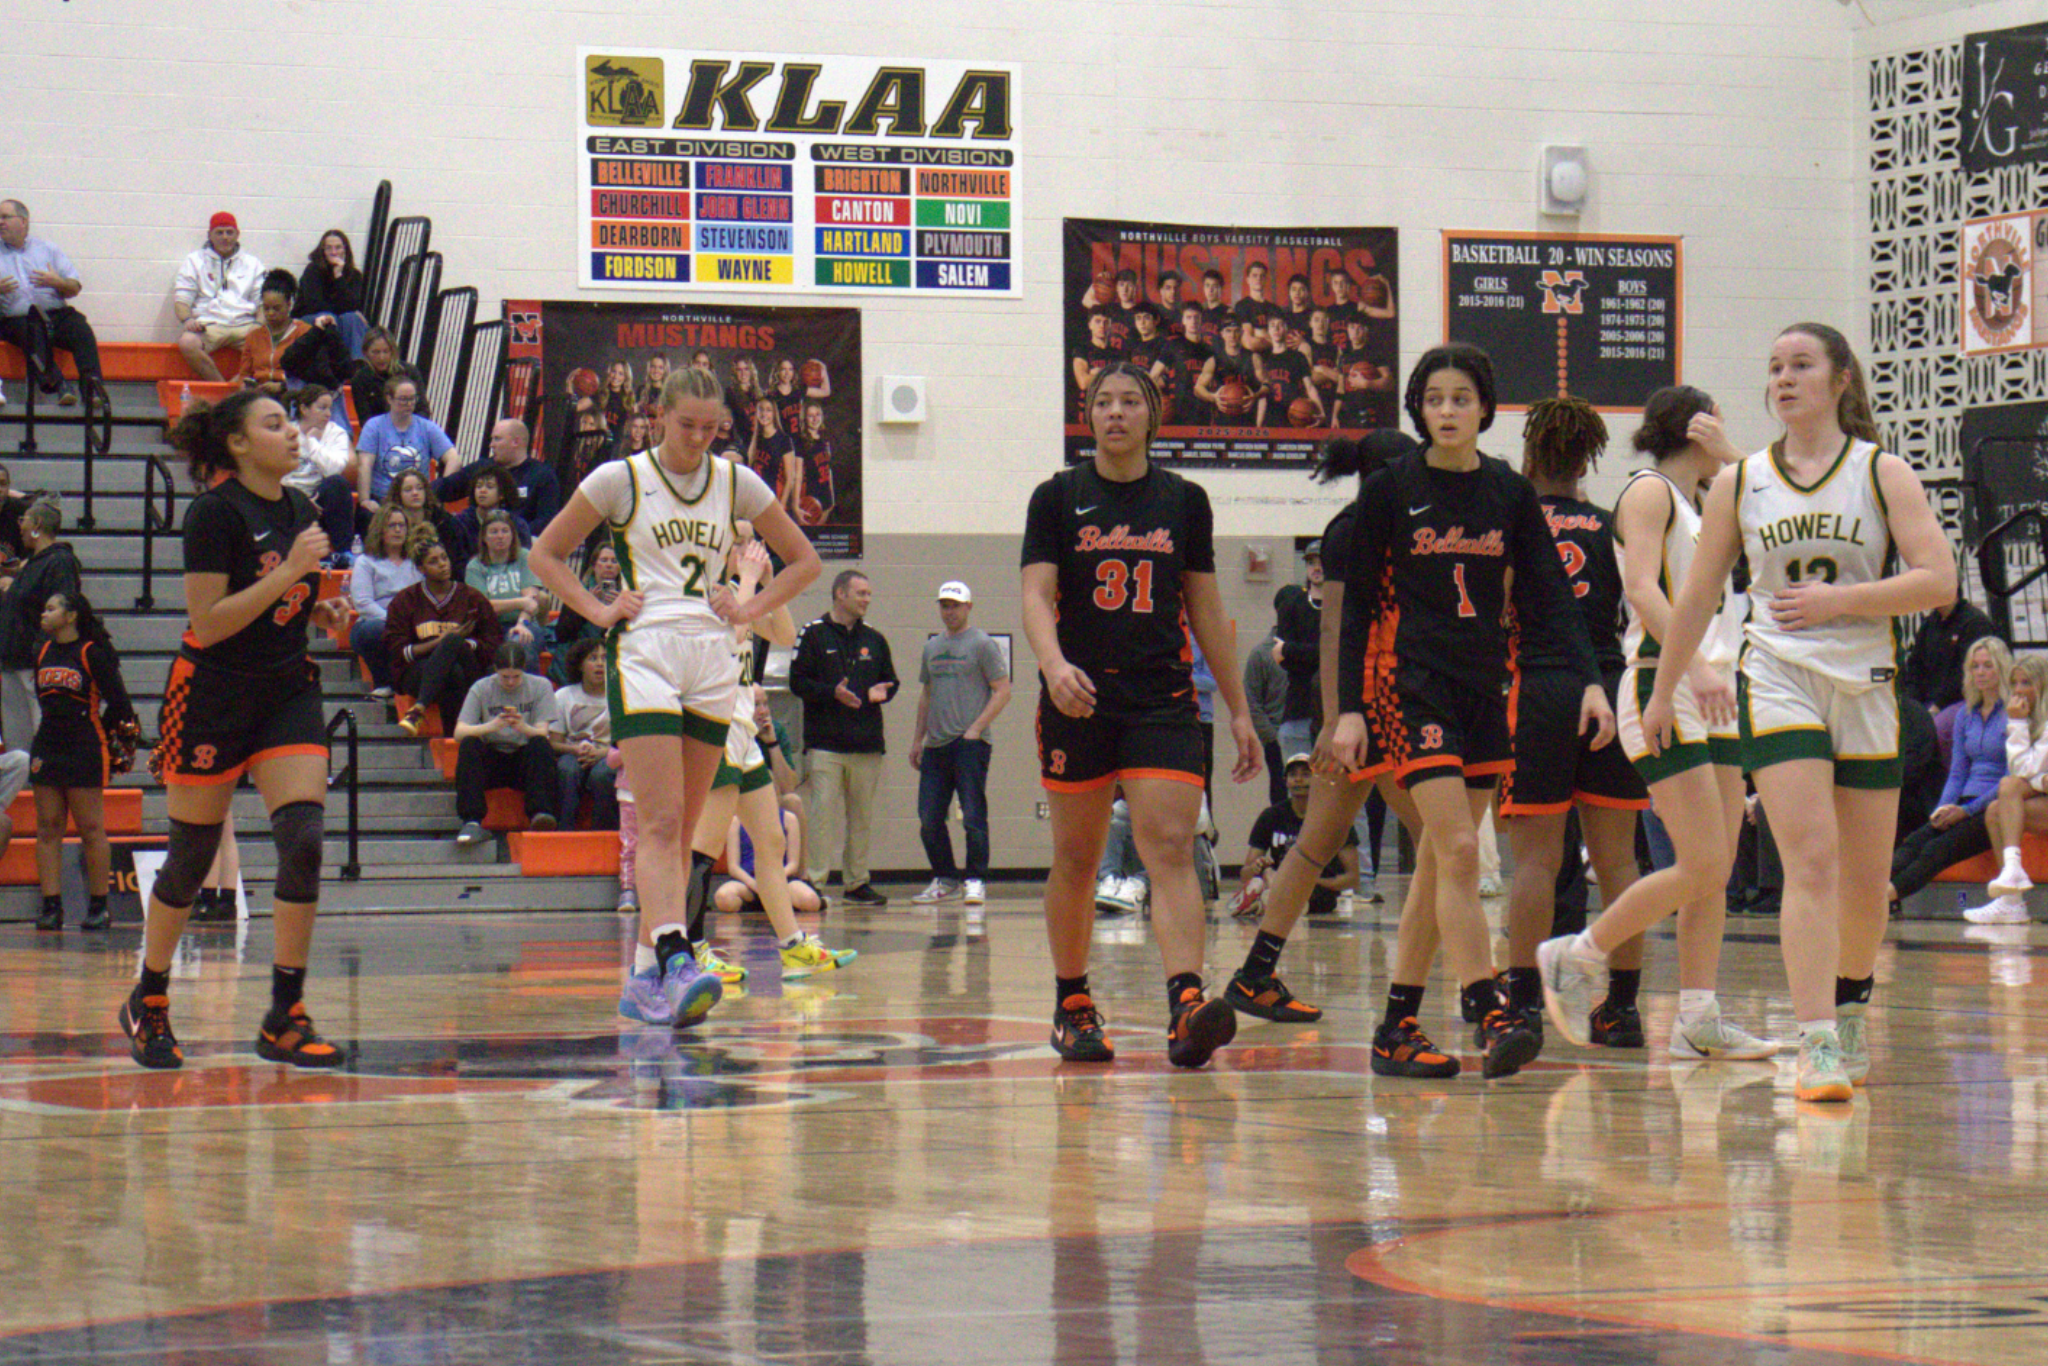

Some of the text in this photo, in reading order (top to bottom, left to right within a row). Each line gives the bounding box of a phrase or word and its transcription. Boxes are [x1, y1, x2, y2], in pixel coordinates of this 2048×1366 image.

[672, 59, 1013, 140] KLAA
[595, 138, 788, 158] EAST DIVISION
[819, 145, 1006, 165] WEST DIVISION
[598, 161, 683, 186] BELLEVILLE
[705, 164, 783, 189] FRANKLIN
[824, 168, 900, 193] BRIGHTON
[919, 173, 1007, 196] NORTHVILLE
[599, 193, 682, 217] CHURCHILL
[700, 195, 789, 220] JOHN GLENN
[832, 200, 894, 223] CANTON
[944, 202, 982, 225] NOVI
[599, 224, 682, 247] DEARBORN
[700, 227, 788, 251] STEVENSON
[823, 230, 903, 254] HARTLAND
[924, 232, 1003, 256] PLYMOUTH
[1120, 231, 1342, 247] NORTHVILLE BOYS VARSITY BASKETBALL
[1452, 244, 1540, 264] BASKETBALL
[1548, 247, 1564, 265] 20
[1575, 248, 1604, 266] WIN
[1607, 249, 1673, 267] SEASONS
[605, 256, 676, 279] FORDSON
[717, 258, 772, 281] WAYNE
[833, 261, 893, 285] HOWELL
[938, 263, 989, 287] SALEM
[1092, 242, 1377, 307] MUSTANGS
[1474, 277, 1508, 291] GIRLS
[1618, 280, 1647, 294] BOYS
[1458, 295, 1524, 309] 2015-2016 (21)
[1647, 298, 1665, 312] (20)
[662, 315, 732, 323] NORTHVILLE
[1601, 314, 1645, 326] 1974-1975
[617, 323, 775, 350] MUSTANGS
[1600, 330, 1646, 342] 2005-2006
[1600, 346, 1665, 361] 2015-2016 (21)
[1198, 428, 1270, 437] 2025-2026
[1075, 524, 1174, 554] Belleville
[1759, 513, 1864, 551] HOWELL
[1093, 559, 1153, 613] 31
[1453, 563, 1476, 617] 1
